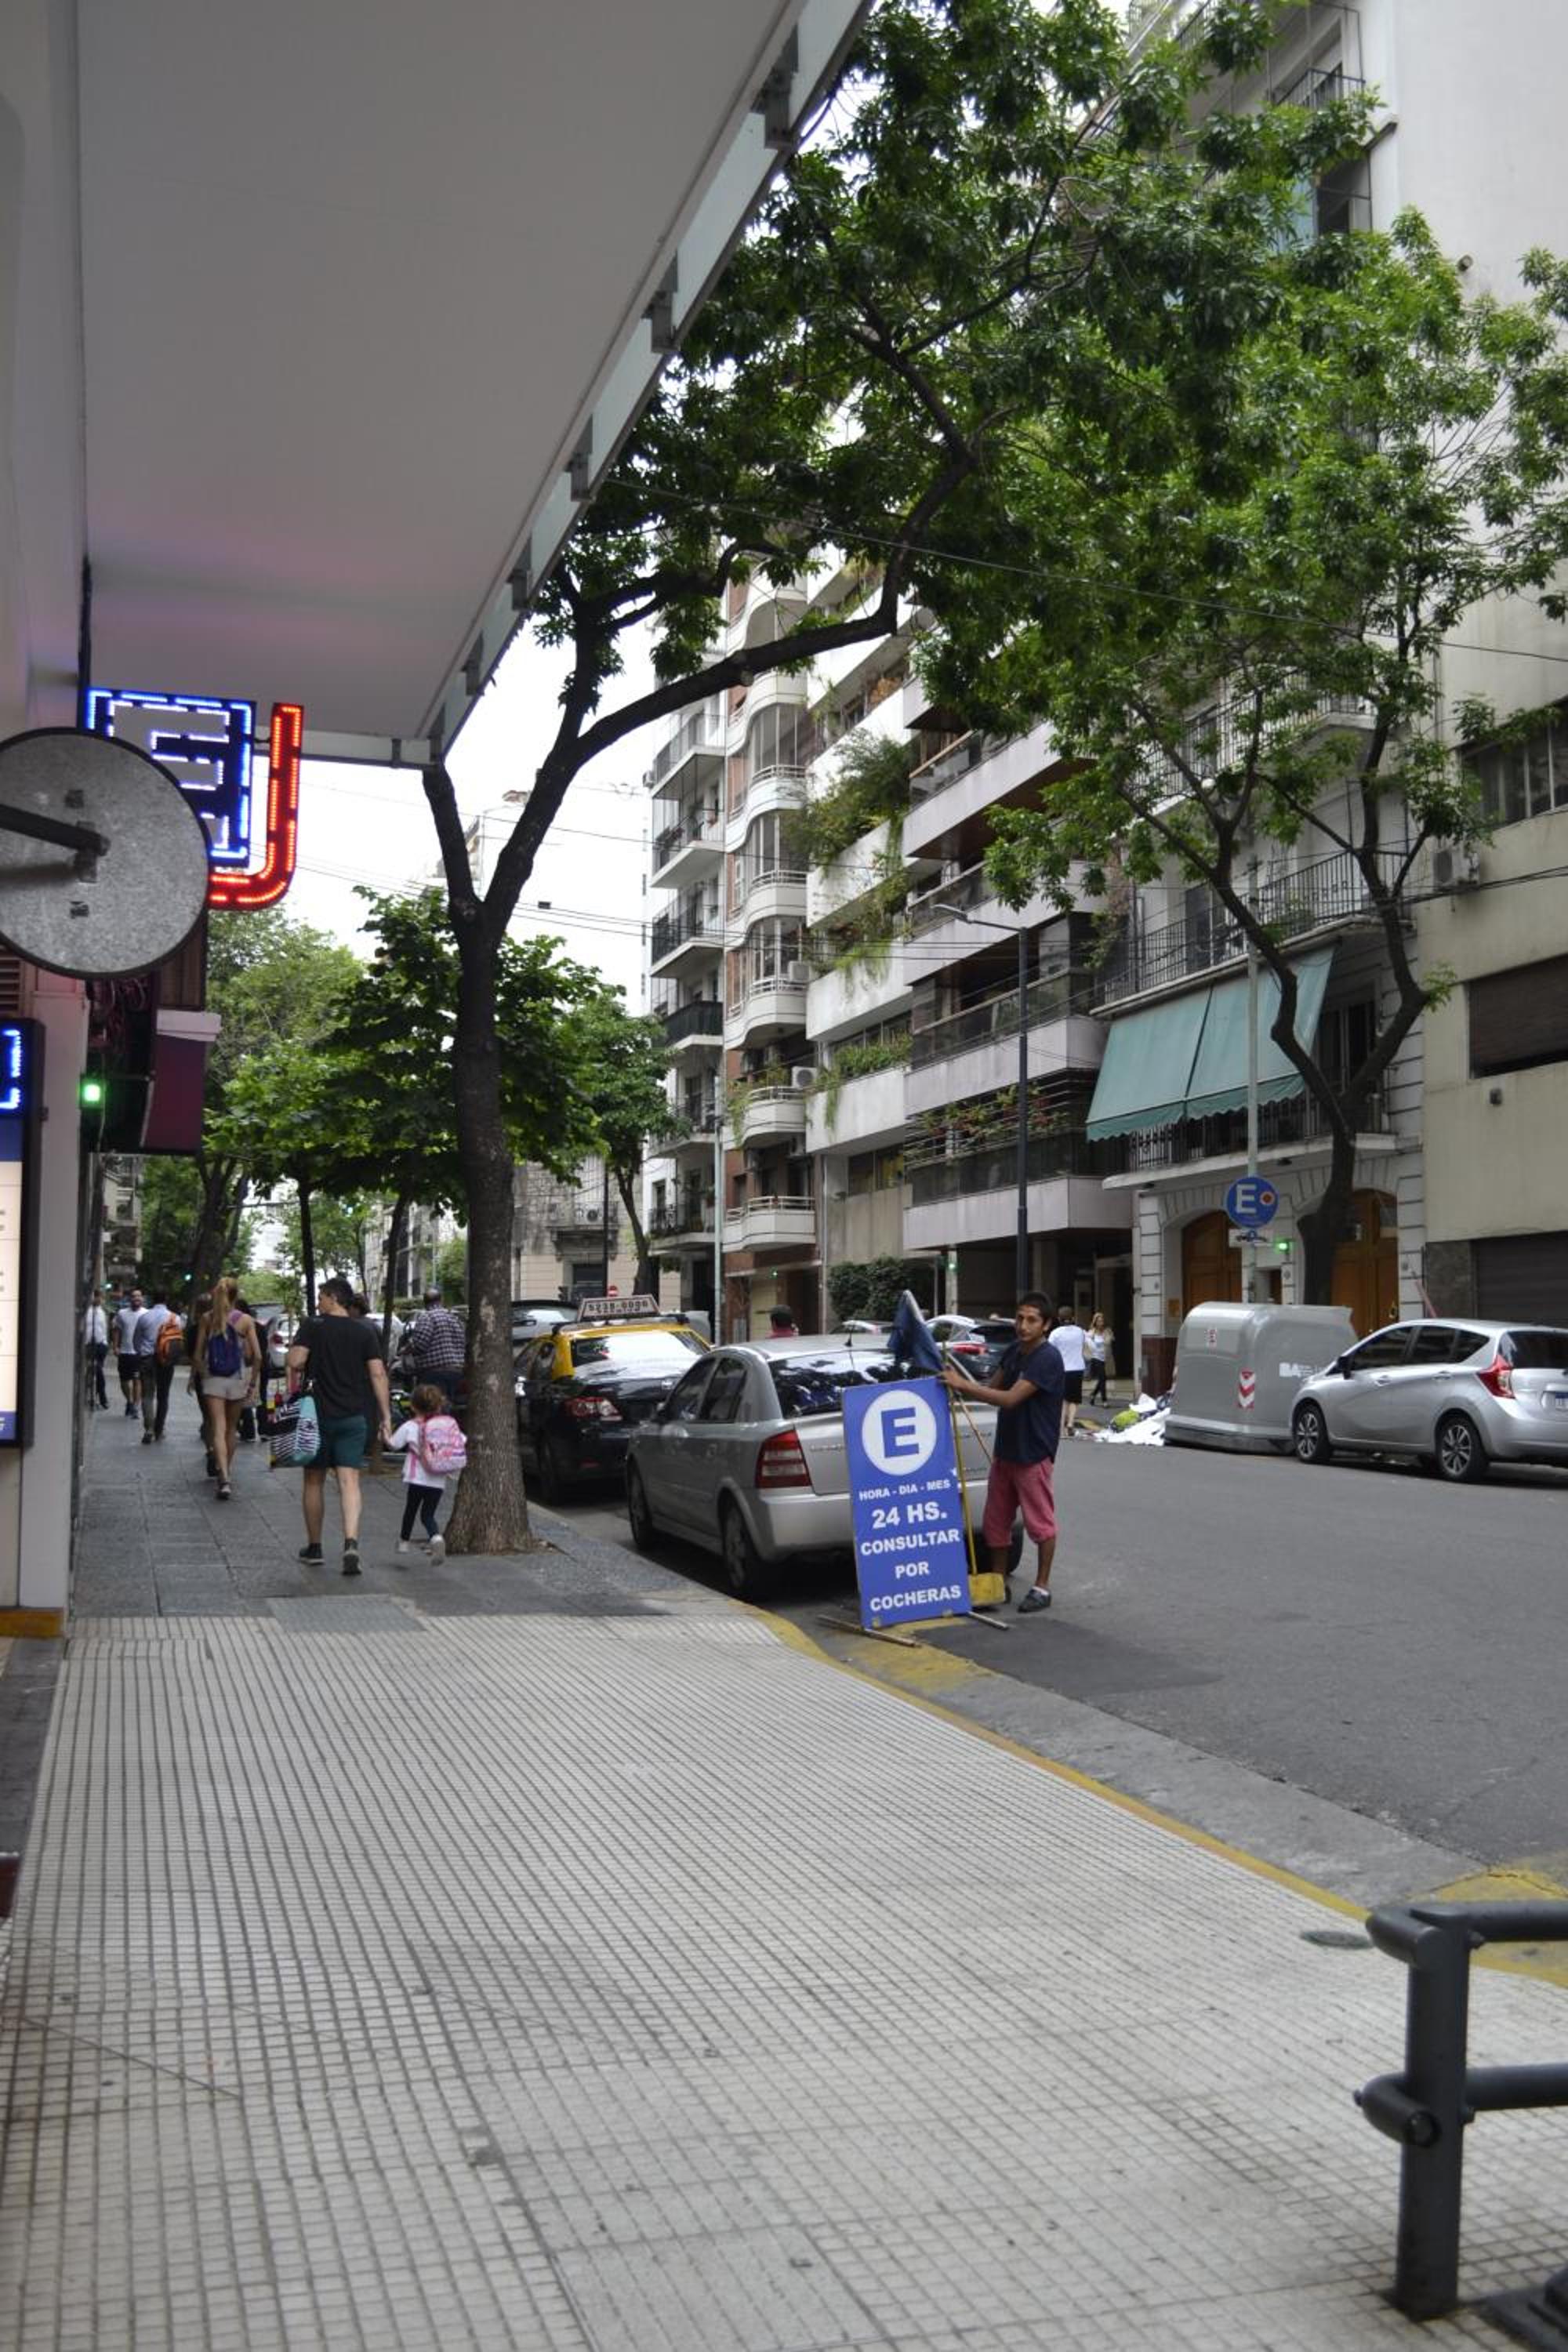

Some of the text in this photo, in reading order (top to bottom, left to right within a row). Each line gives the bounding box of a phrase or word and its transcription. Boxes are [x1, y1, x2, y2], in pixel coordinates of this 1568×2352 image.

[1236, 1183, 1257, 1214] E
[880, 1406, 920, 1459] E
[859, 1488, 891, 1501] HORA
[898, 1483, 918, 1495] DIA
[927, 1479, 951, 1490] MES
[872, 1501, 947, 1529] 24 HS.
[860, 1529, 960, 1555] CONSULTAR
[895, 1561, 930, 1579] POR
[870, 1584, 961, 1611] COCHERAS
